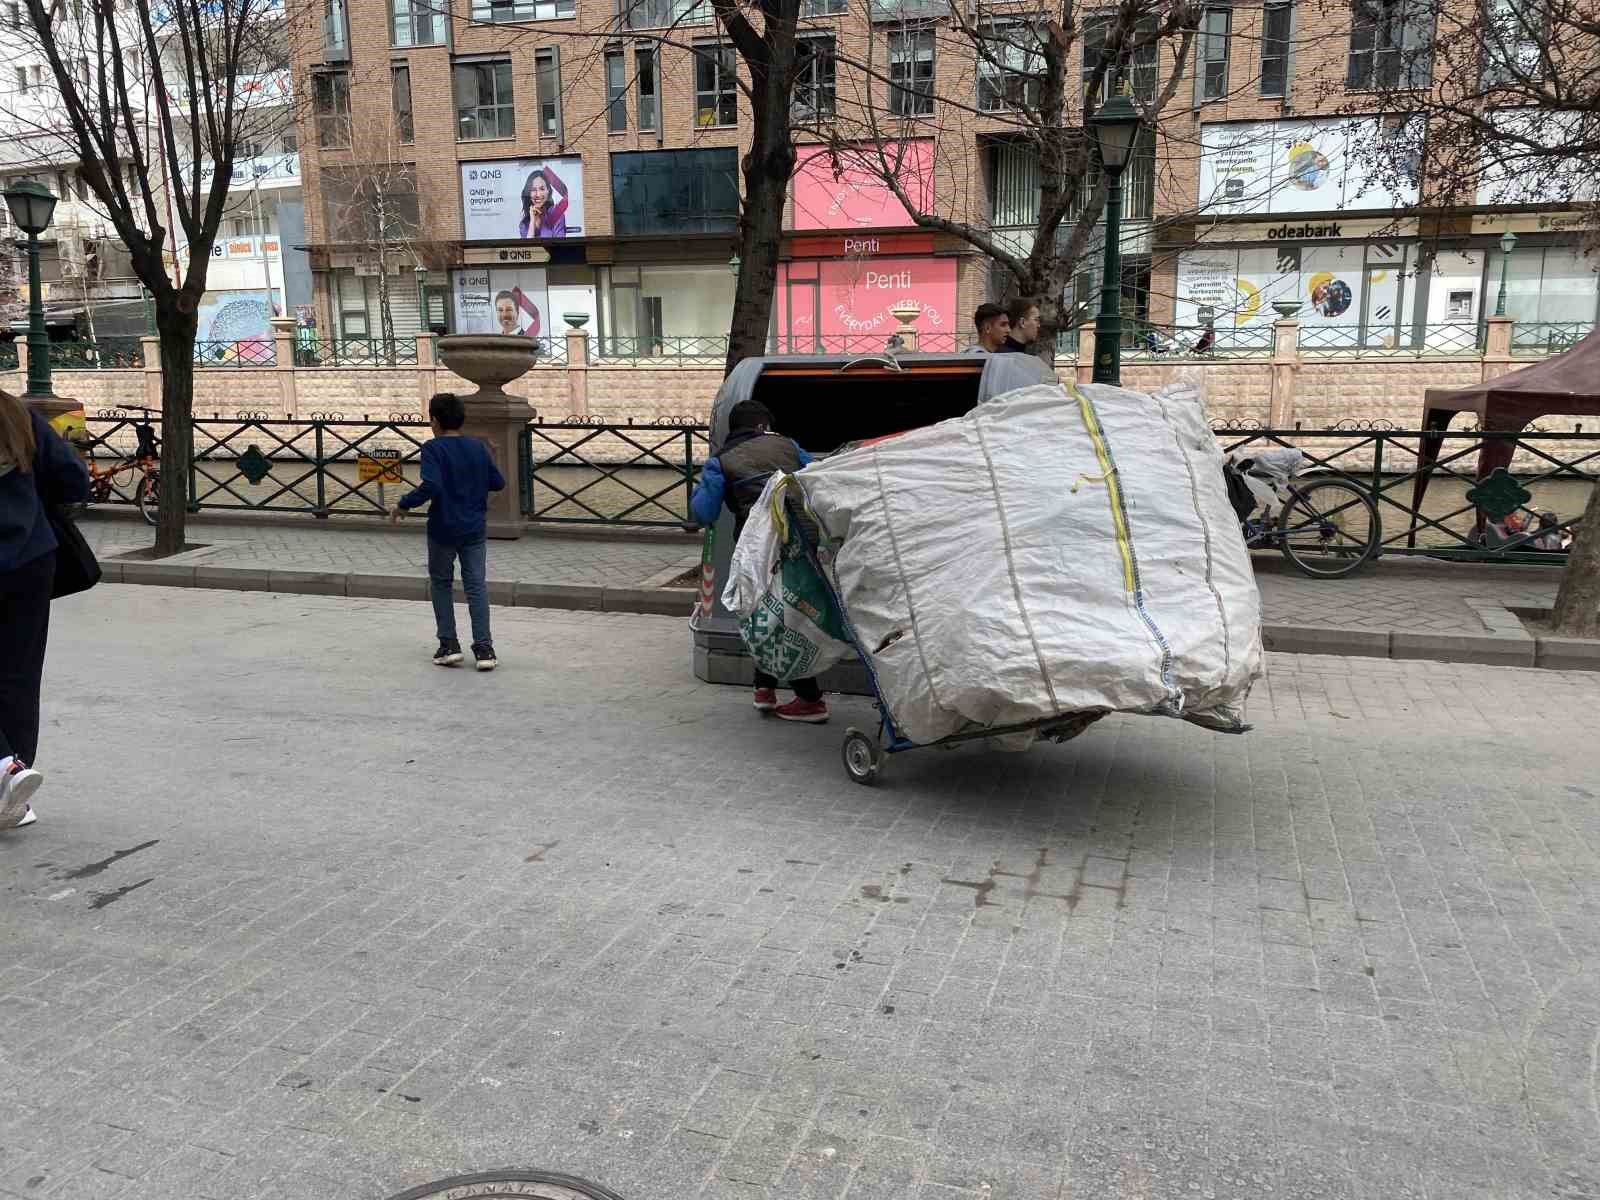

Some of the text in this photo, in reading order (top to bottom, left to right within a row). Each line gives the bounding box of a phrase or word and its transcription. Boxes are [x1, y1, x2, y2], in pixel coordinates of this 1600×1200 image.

[480, 169, 502, 180] QNB
[1267, 222, 1342, 240] odeabank
[844, 238, 881, 253] Penti
[509, 250, 532, 260] QNB
[865, 270, 912, 289] Penti
